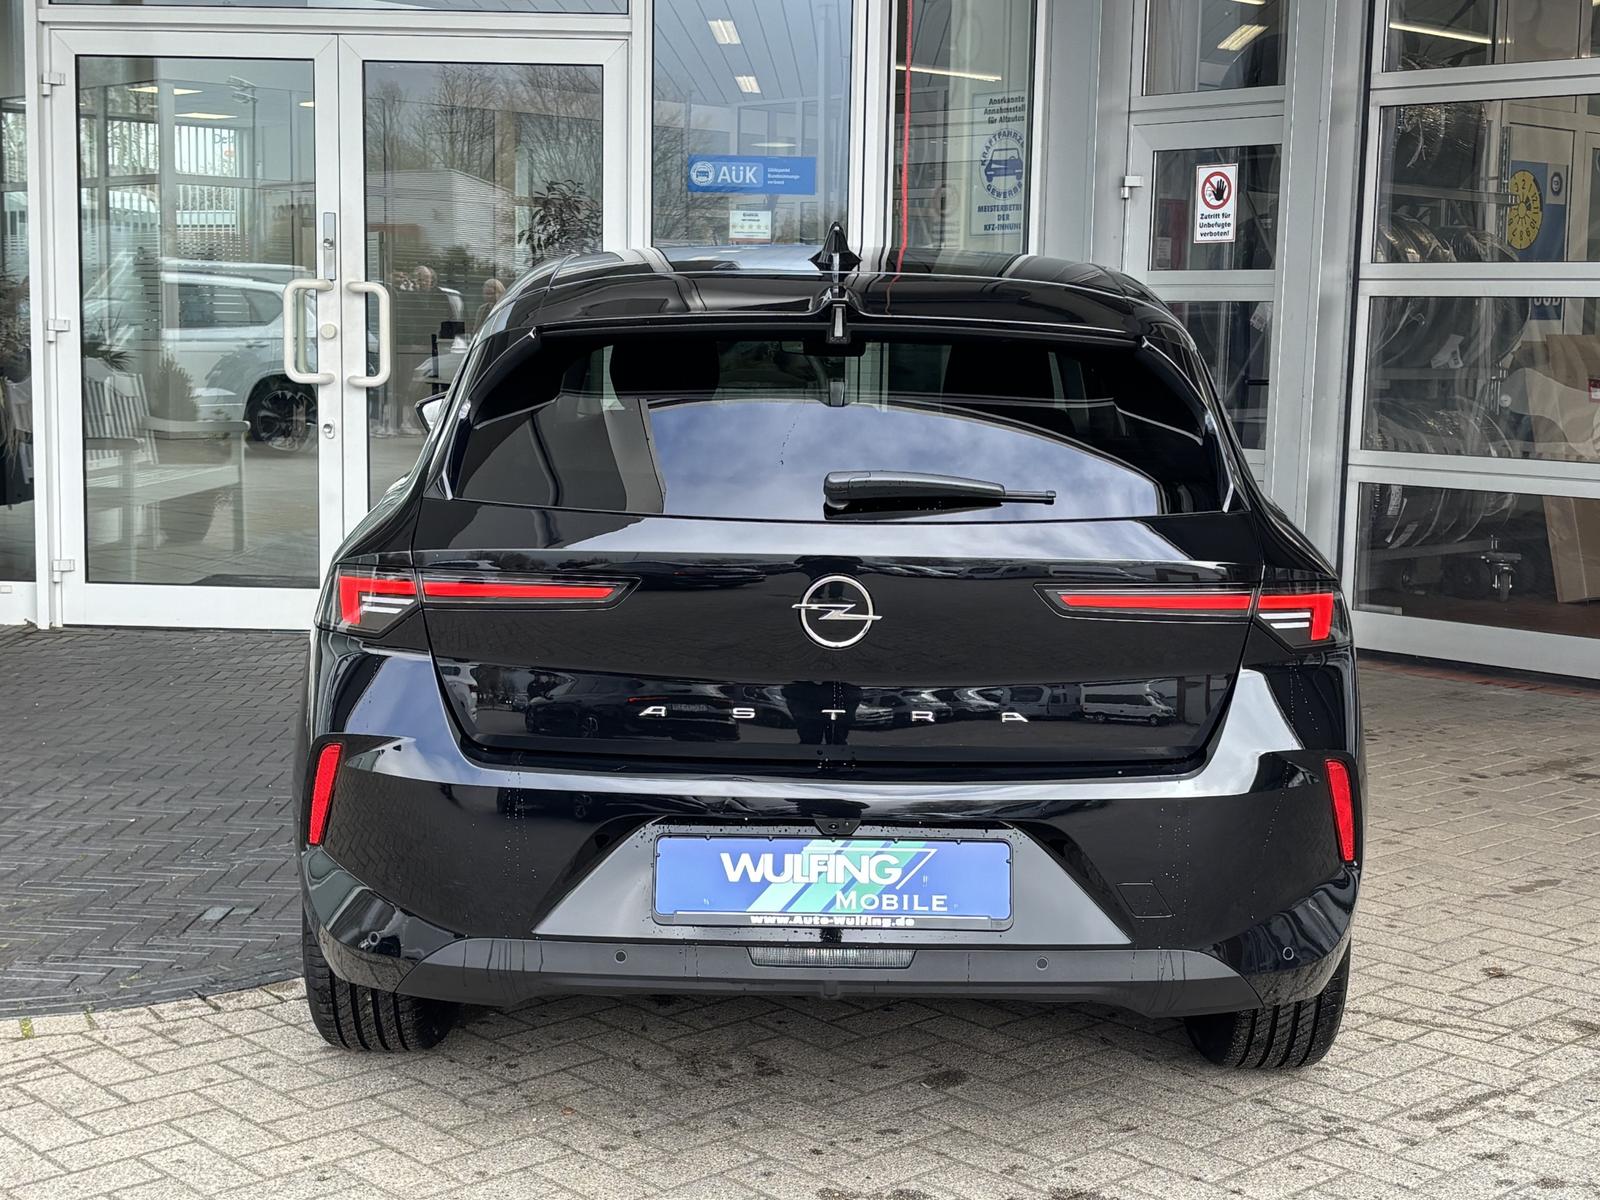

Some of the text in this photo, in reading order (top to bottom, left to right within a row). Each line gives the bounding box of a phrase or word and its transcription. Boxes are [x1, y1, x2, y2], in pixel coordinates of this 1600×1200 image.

[988, 116, 997, 124] für
[997, 214, 1010, 222] DER
[639, 706, 1029, 723] ASTRA
[720, 852, 902, 885] WULFING
